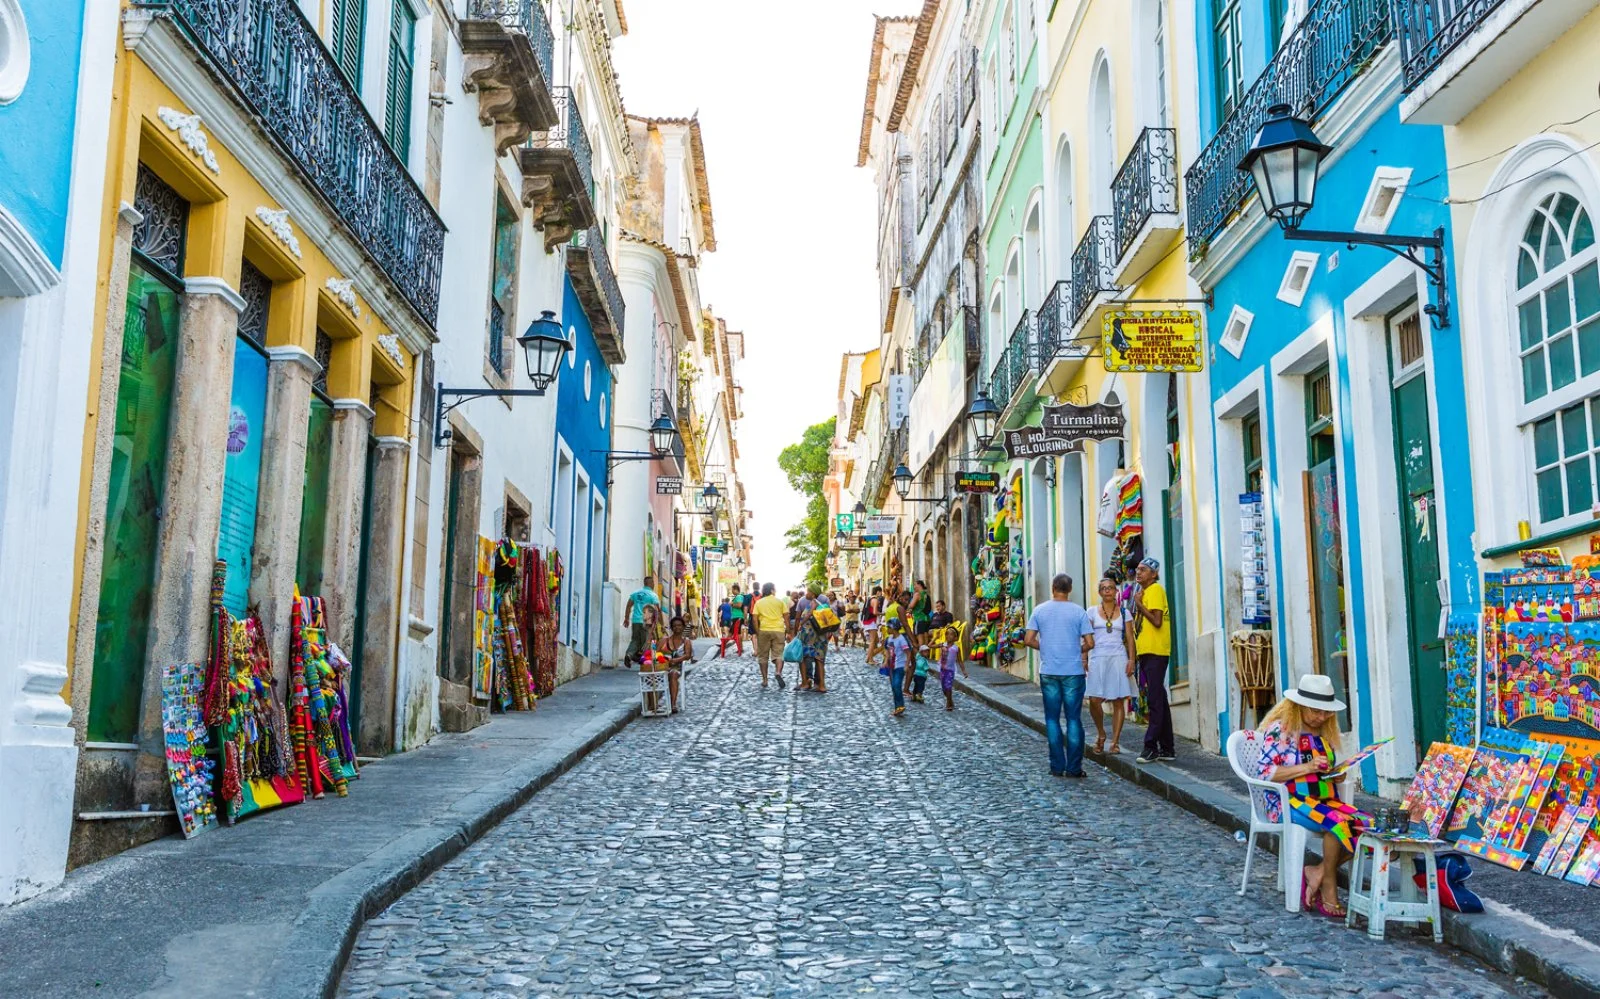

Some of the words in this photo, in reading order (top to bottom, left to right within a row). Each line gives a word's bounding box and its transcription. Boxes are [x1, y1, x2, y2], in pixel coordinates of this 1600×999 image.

[1138, 326, 1175, 334] MUSICAL
[1050, 414, 1118, 425] Turmalina
[1014, 442, 1074, 455] PELOURINHO
